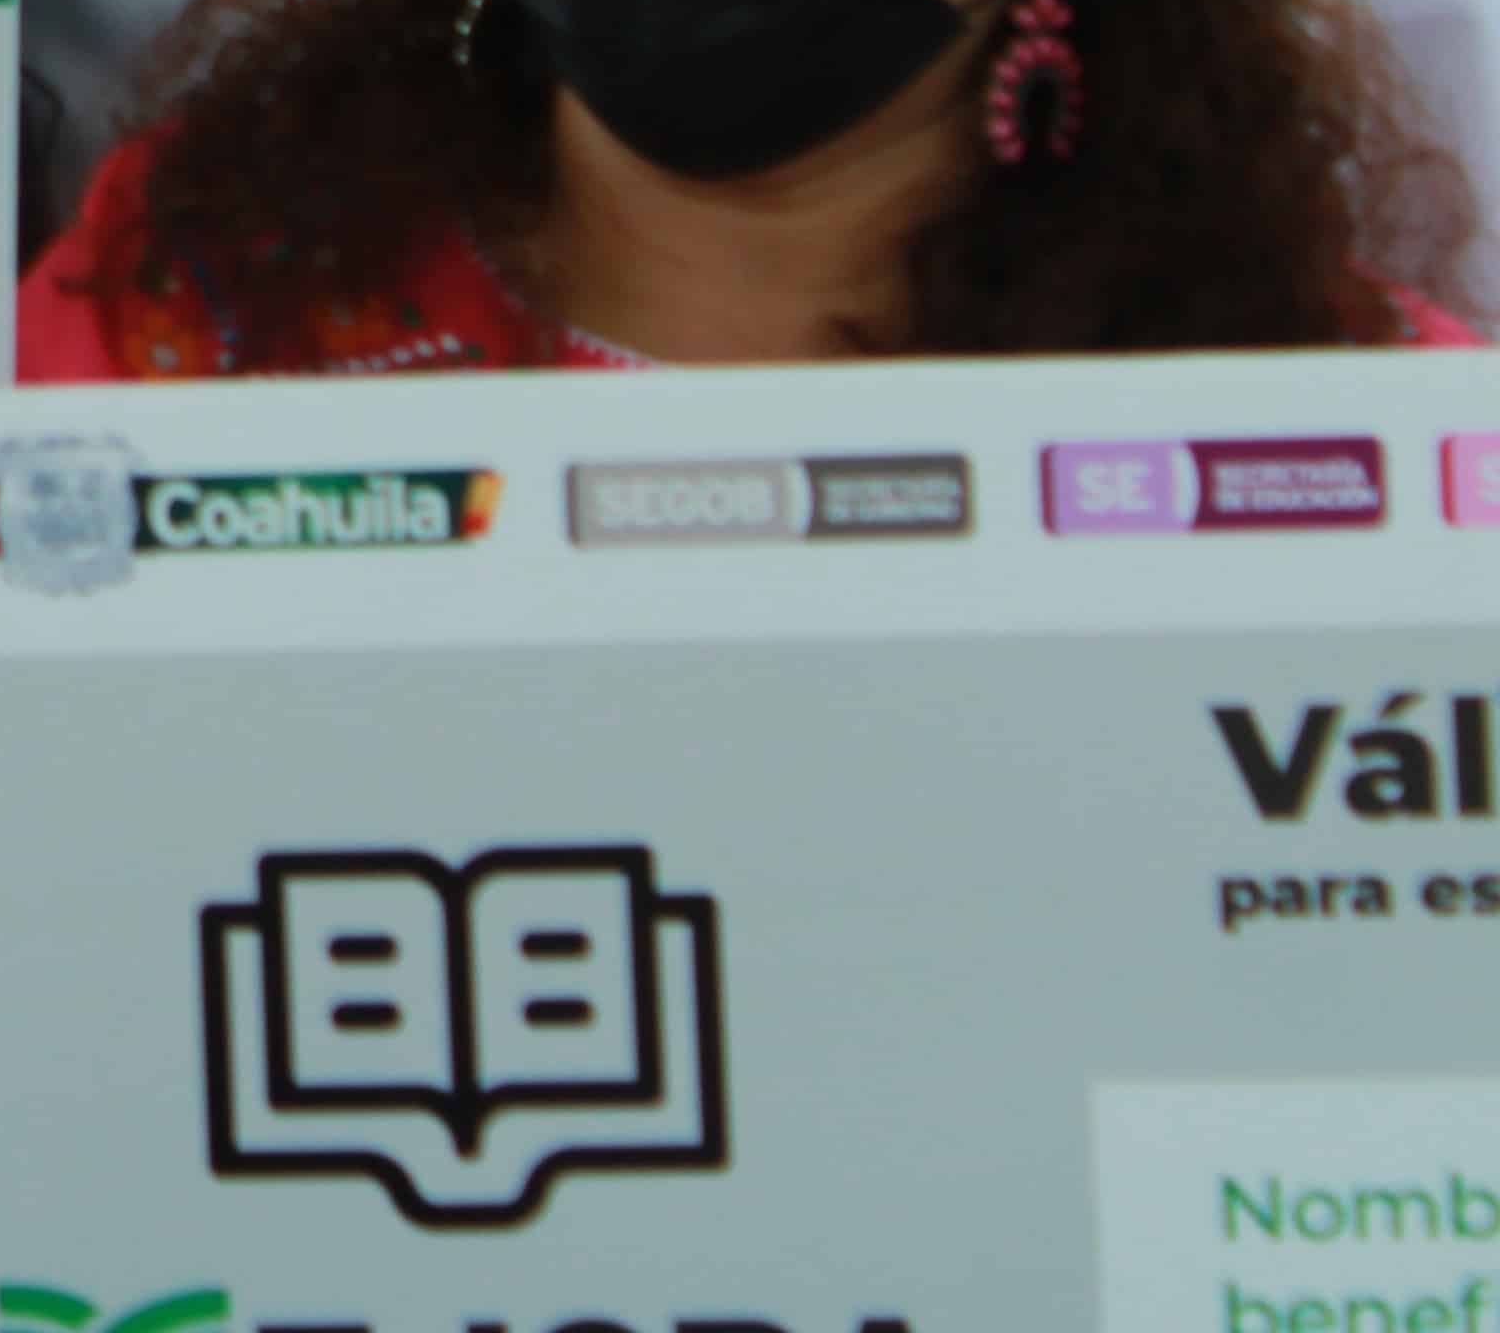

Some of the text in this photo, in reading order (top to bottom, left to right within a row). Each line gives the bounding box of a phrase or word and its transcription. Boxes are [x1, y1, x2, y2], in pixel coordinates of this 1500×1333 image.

[144, 466, 458, 551] Coahuila
[1211, 692, 1493, 820] Vál
[1218, 874, 1393, 933] para
[1218, 1172, 1500, 1243] Nomb
